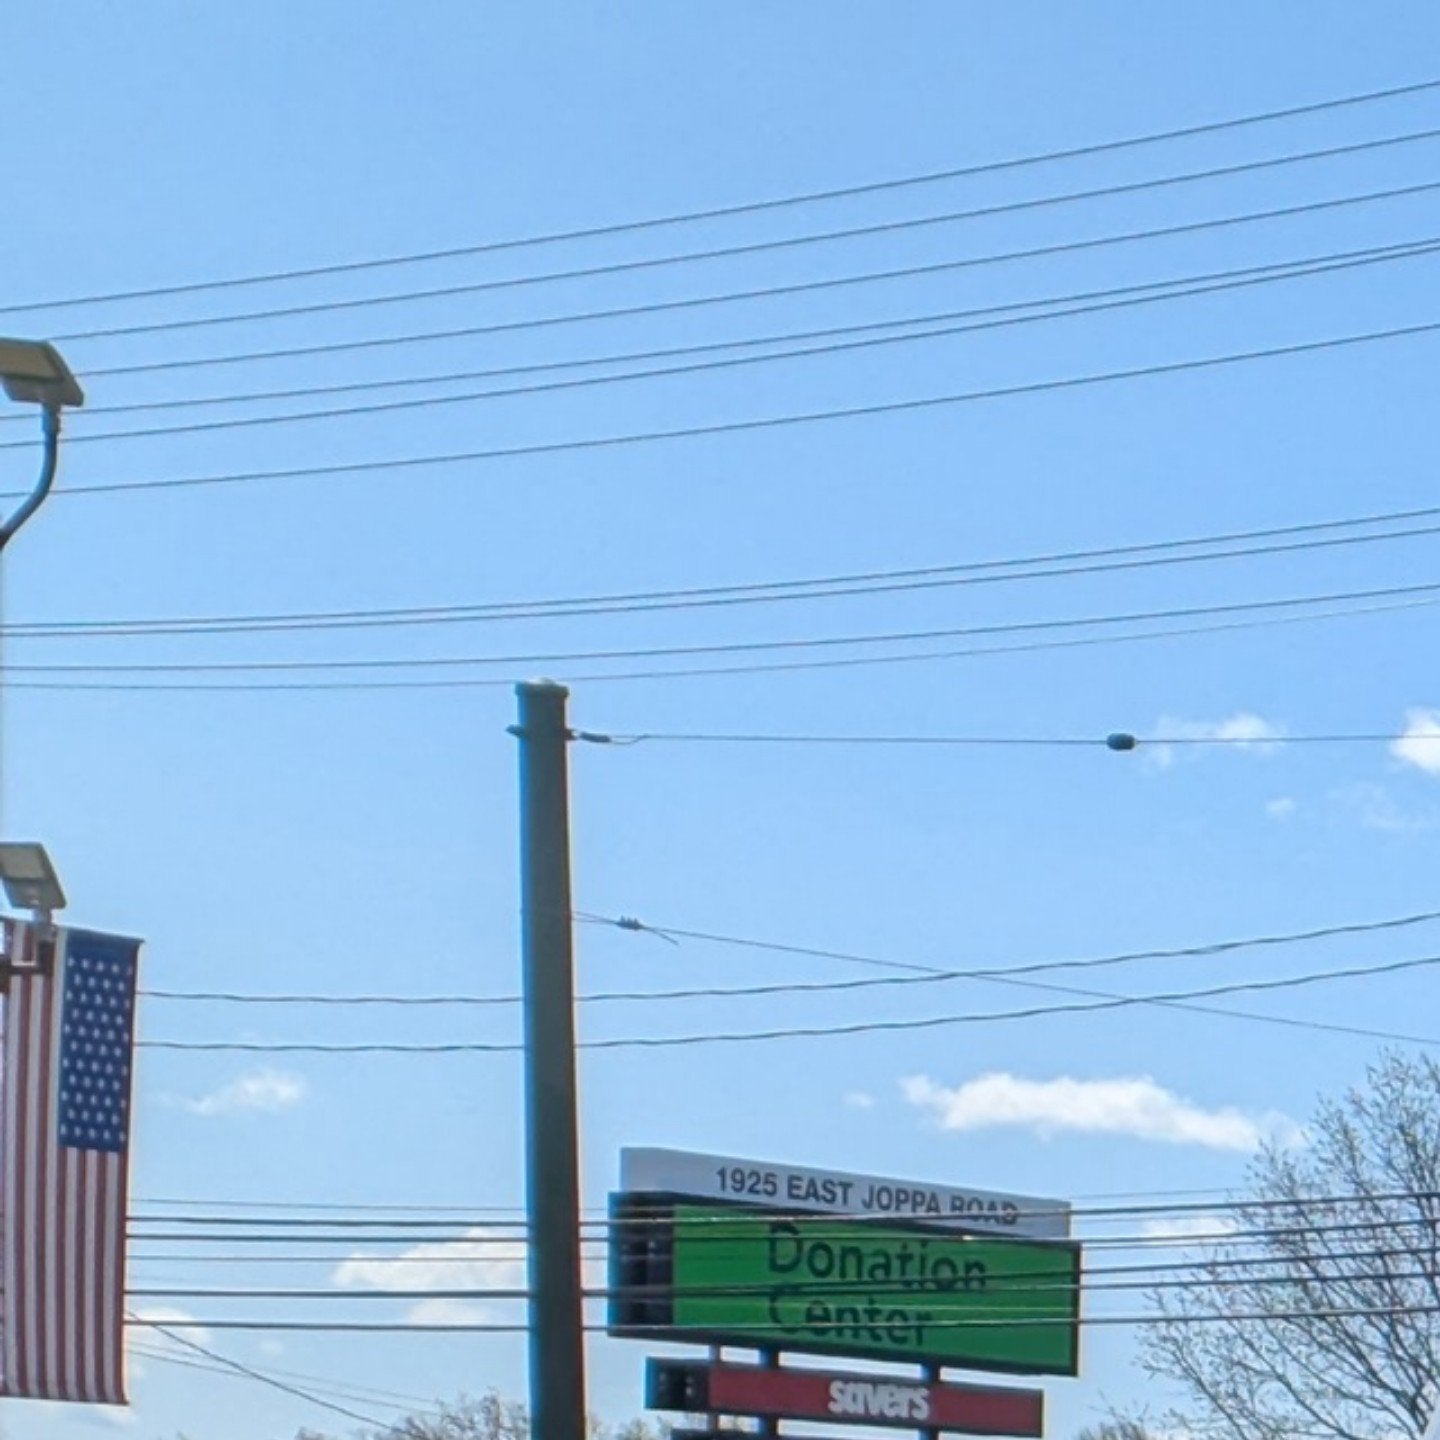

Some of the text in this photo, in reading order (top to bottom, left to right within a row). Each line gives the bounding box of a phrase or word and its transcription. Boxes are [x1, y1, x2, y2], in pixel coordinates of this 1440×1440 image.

[716, 1166, 1019, 1227] 1925 EAST JOPPA ROAD
[768, 1221, 988, 1291] Donation
[768, 1285, 931, 1347] Center
